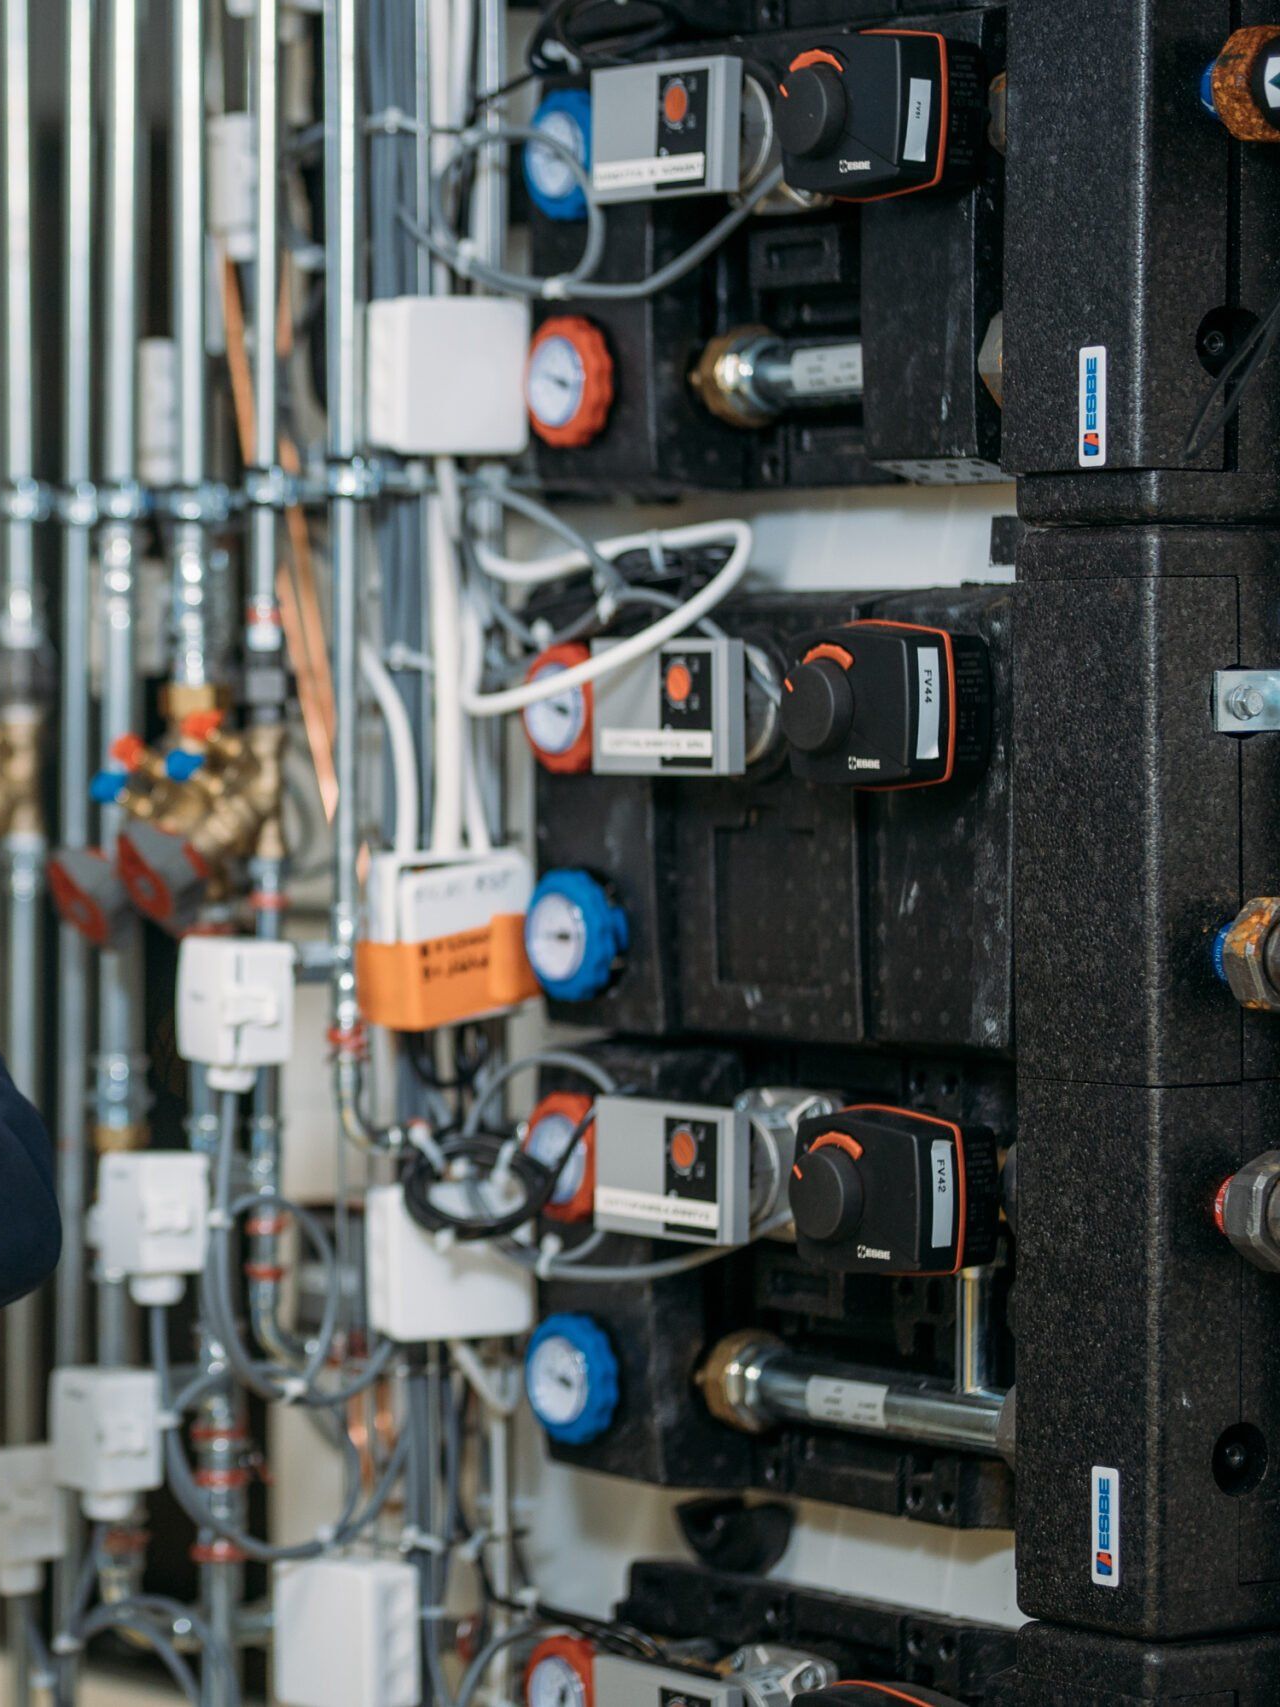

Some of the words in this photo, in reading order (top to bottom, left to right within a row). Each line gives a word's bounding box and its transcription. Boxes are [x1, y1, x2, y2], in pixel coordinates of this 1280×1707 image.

[1086, 357, 1097, 430] ESBE
[924, 669, 933, 704] FV44
[937, 1159, 947, 1193] FV42
[1099, 1477, 1110, 1550] ESBE
